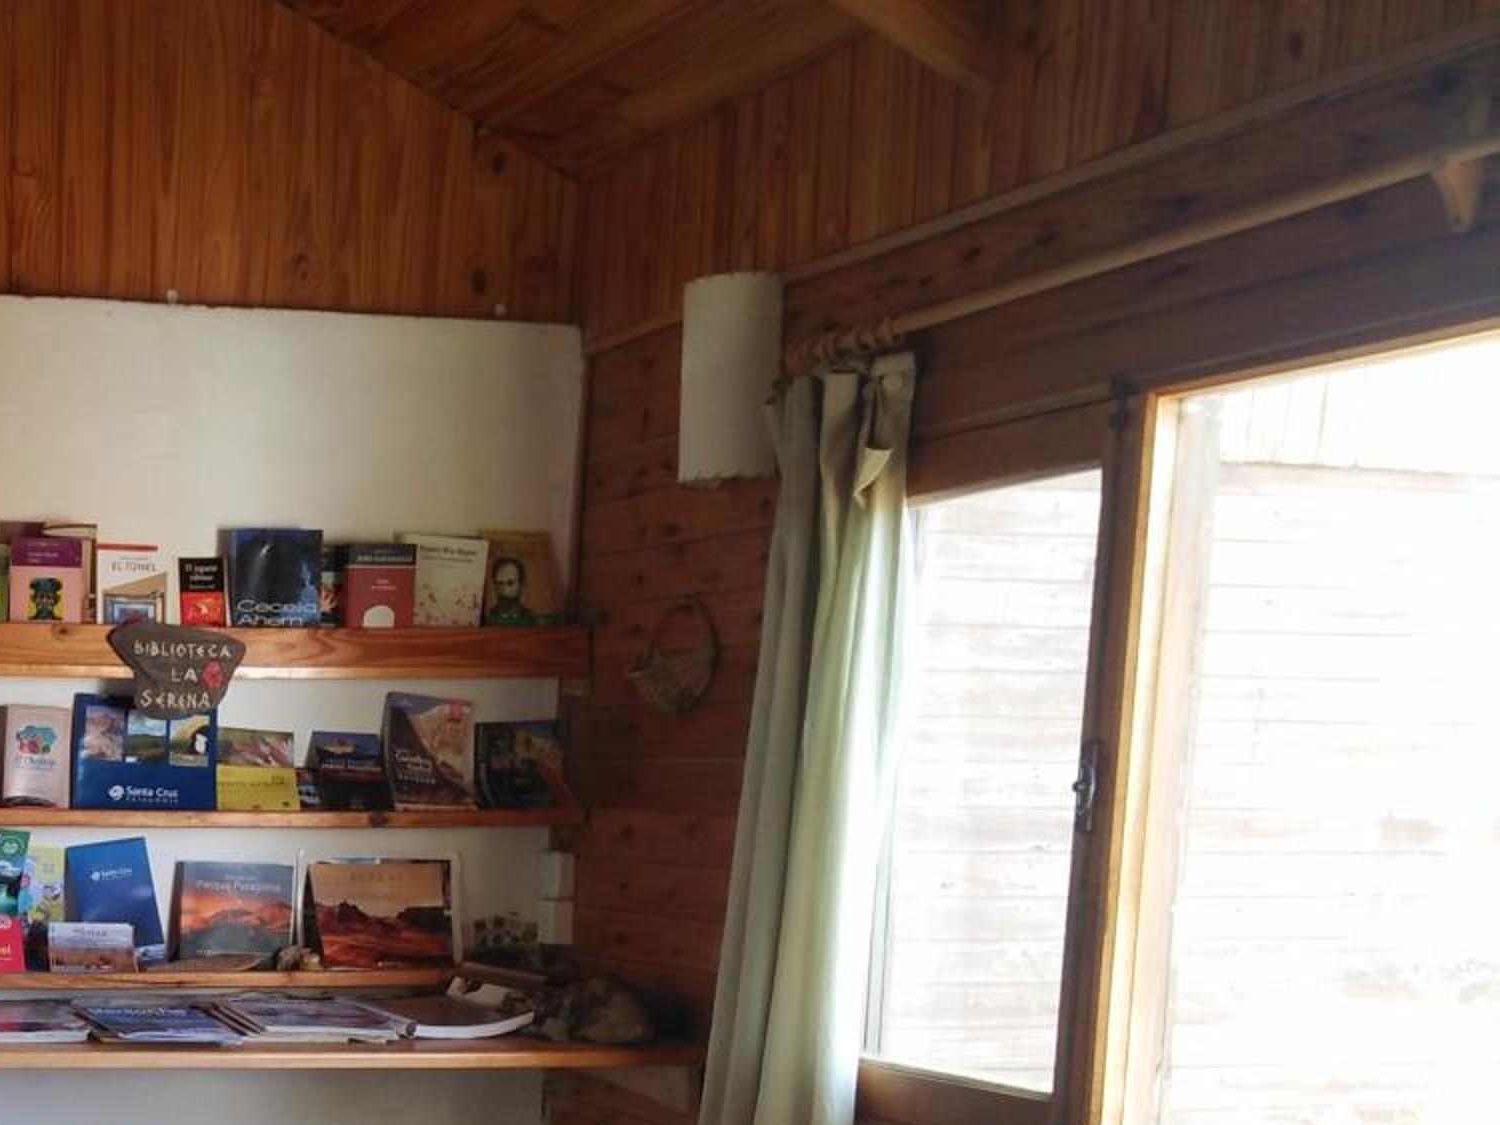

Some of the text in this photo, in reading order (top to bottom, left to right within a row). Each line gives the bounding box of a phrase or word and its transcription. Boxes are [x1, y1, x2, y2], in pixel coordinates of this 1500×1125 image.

[133, 640, 231, 659] BIBLIOTECA
[171, 667, 198, 683] LA
[140, 688, 210, 710] SERENA
[126, 785, 179, 798] Santa Cruz
